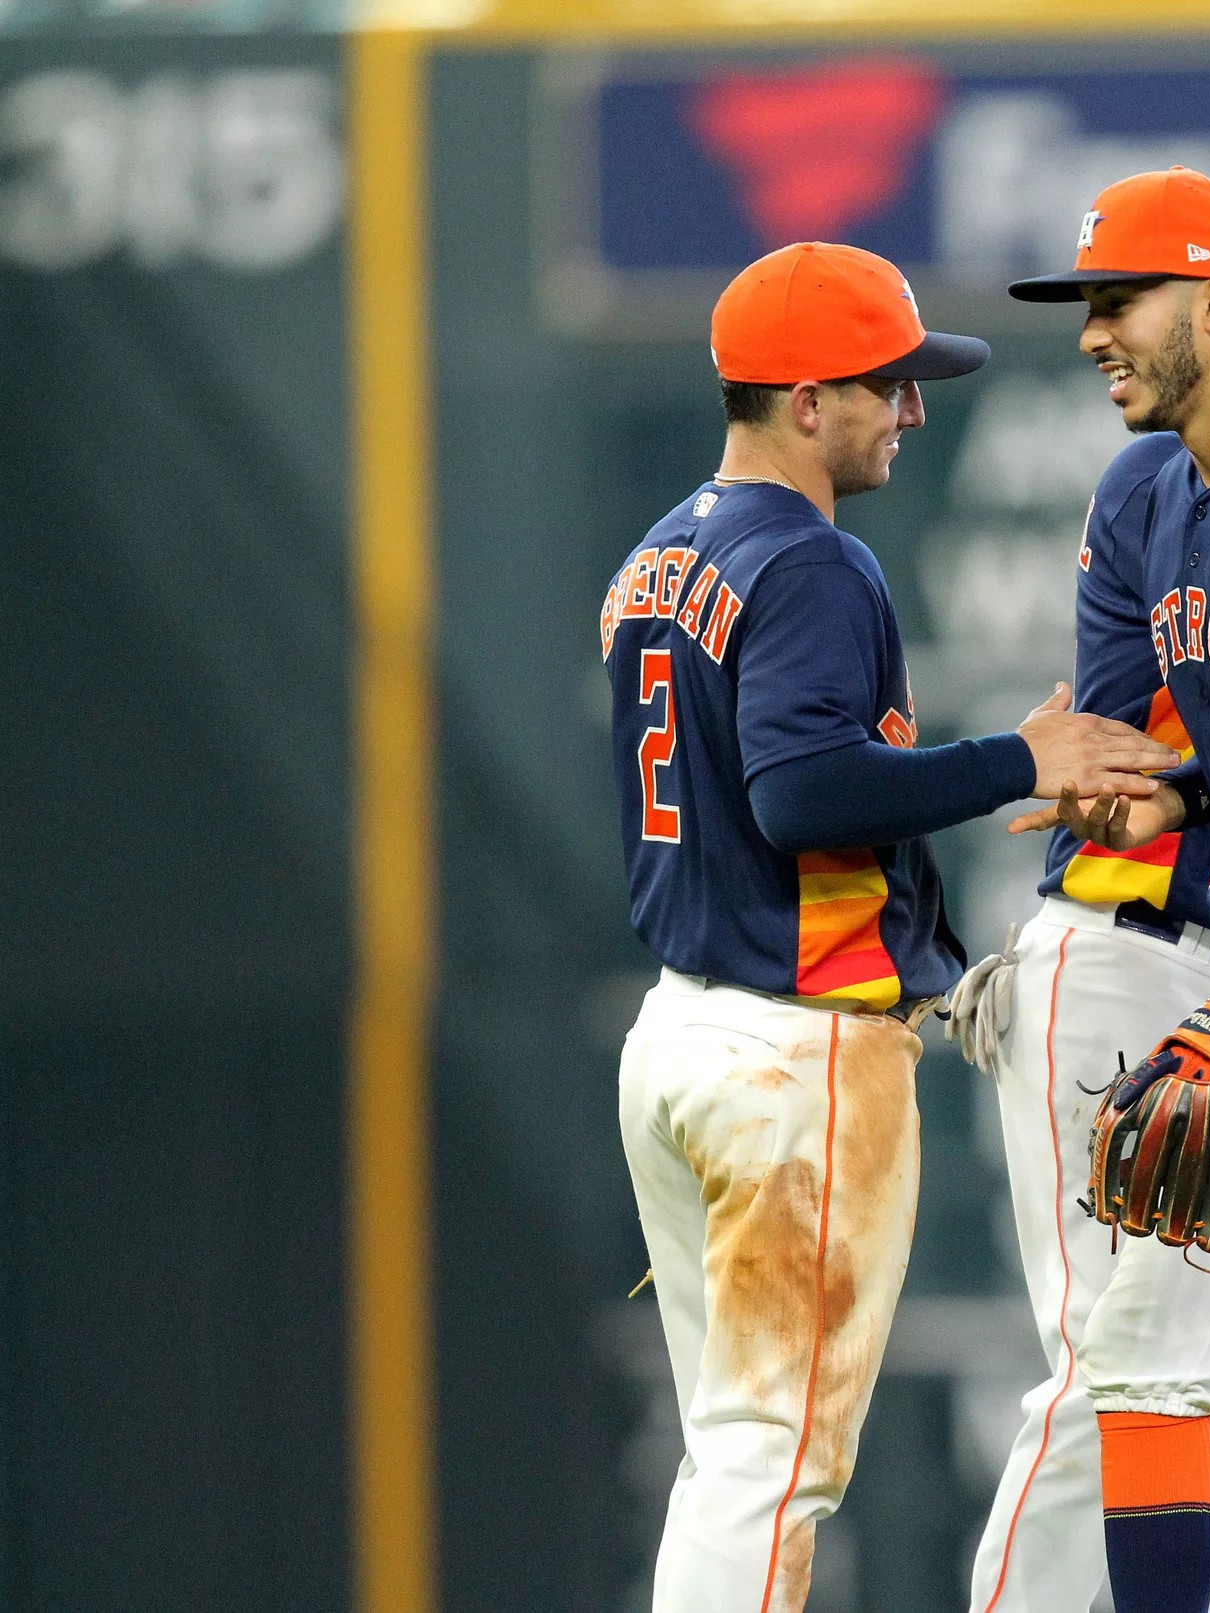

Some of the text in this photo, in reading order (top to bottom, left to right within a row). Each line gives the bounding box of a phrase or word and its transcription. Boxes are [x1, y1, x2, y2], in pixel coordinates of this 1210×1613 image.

[0, 70, 340, 270] 315
[600, 547, 744, 666] BREGAN
[638, 648, 681, 844] 2
